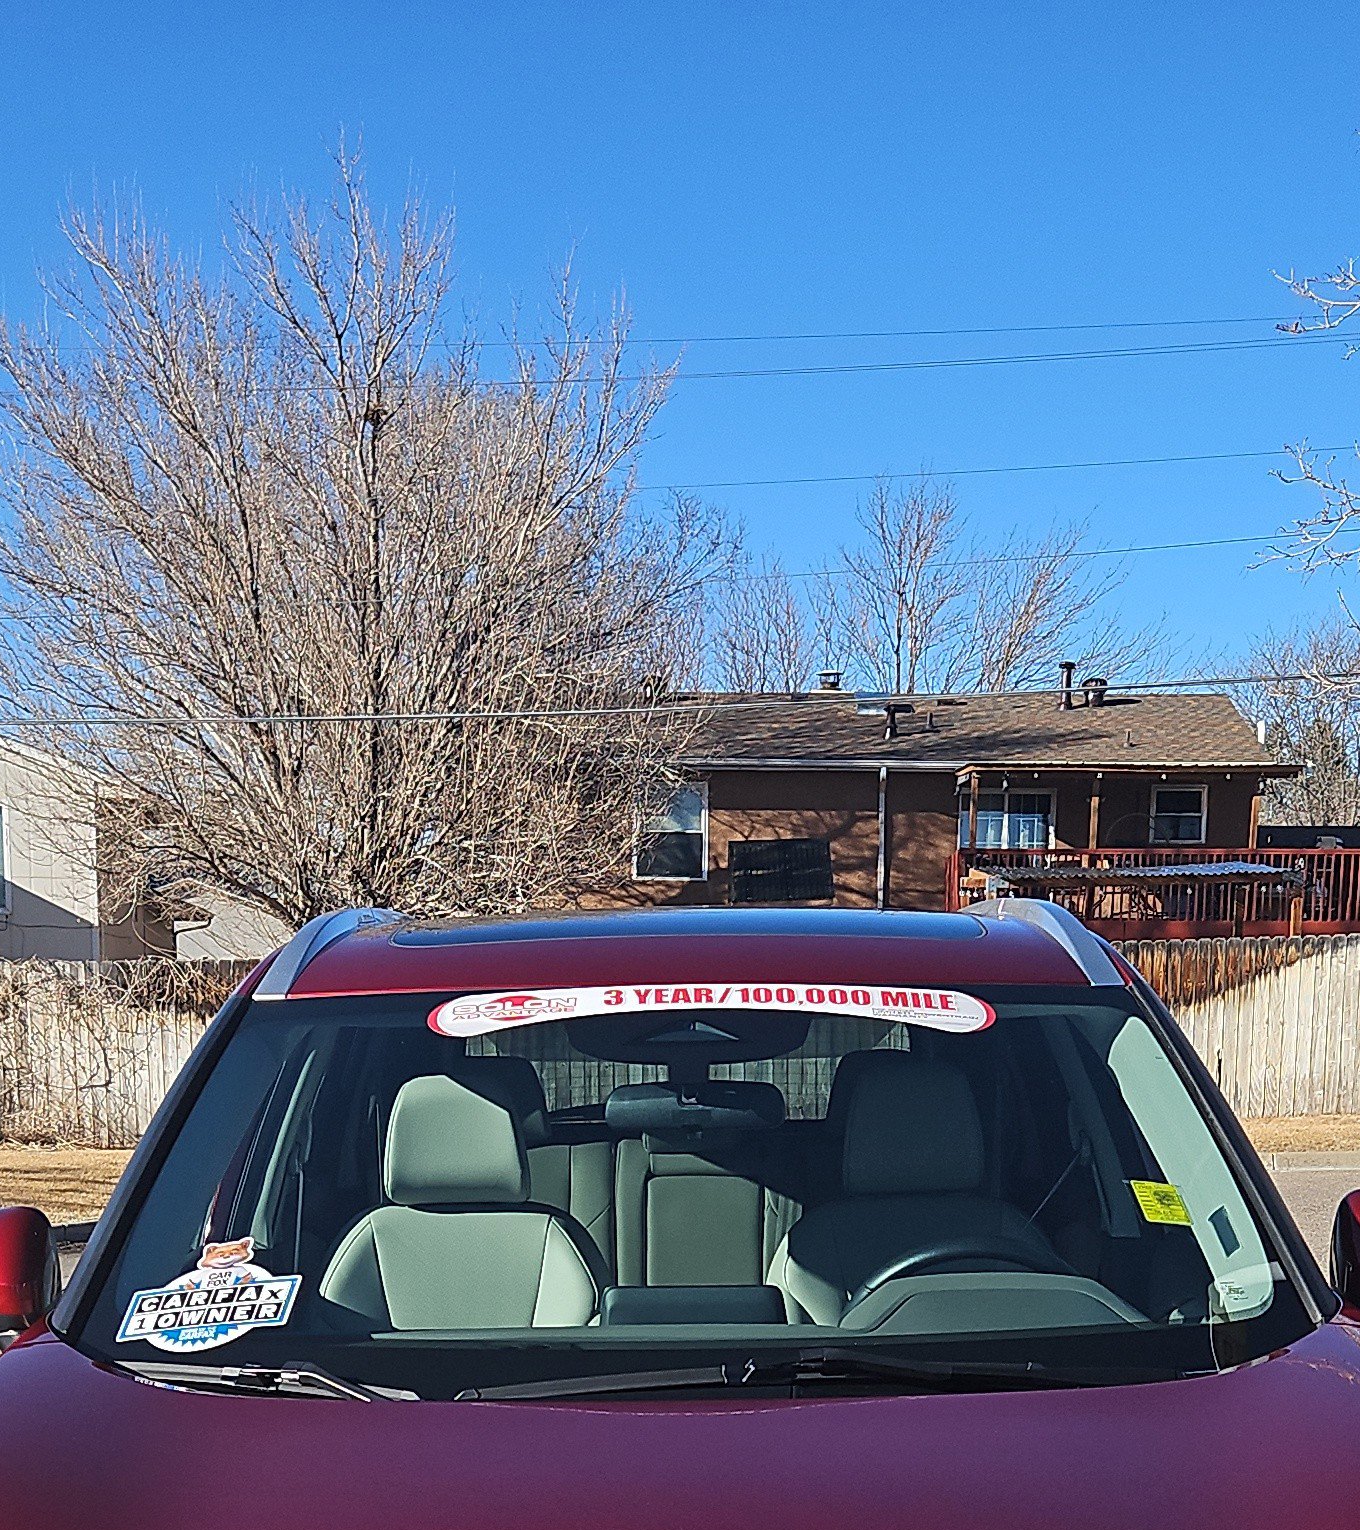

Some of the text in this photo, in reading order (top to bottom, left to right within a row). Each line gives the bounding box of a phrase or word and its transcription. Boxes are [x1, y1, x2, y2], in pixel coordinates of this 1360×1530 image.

[452, 997, 578, 1016] SOLON
[603, 989, 625, 1006] 3
[880, 990, 957, 1011] MILE
[452, 1006, 575, 1021] ADVANTAGE
[206, 1278, 230, 1288] FOX
[208, 1271, 233, 1281] CAR
[139, 1286, 285, 1312] CARFAX
[133, 1303, 281, 1331] 1 OWNER
